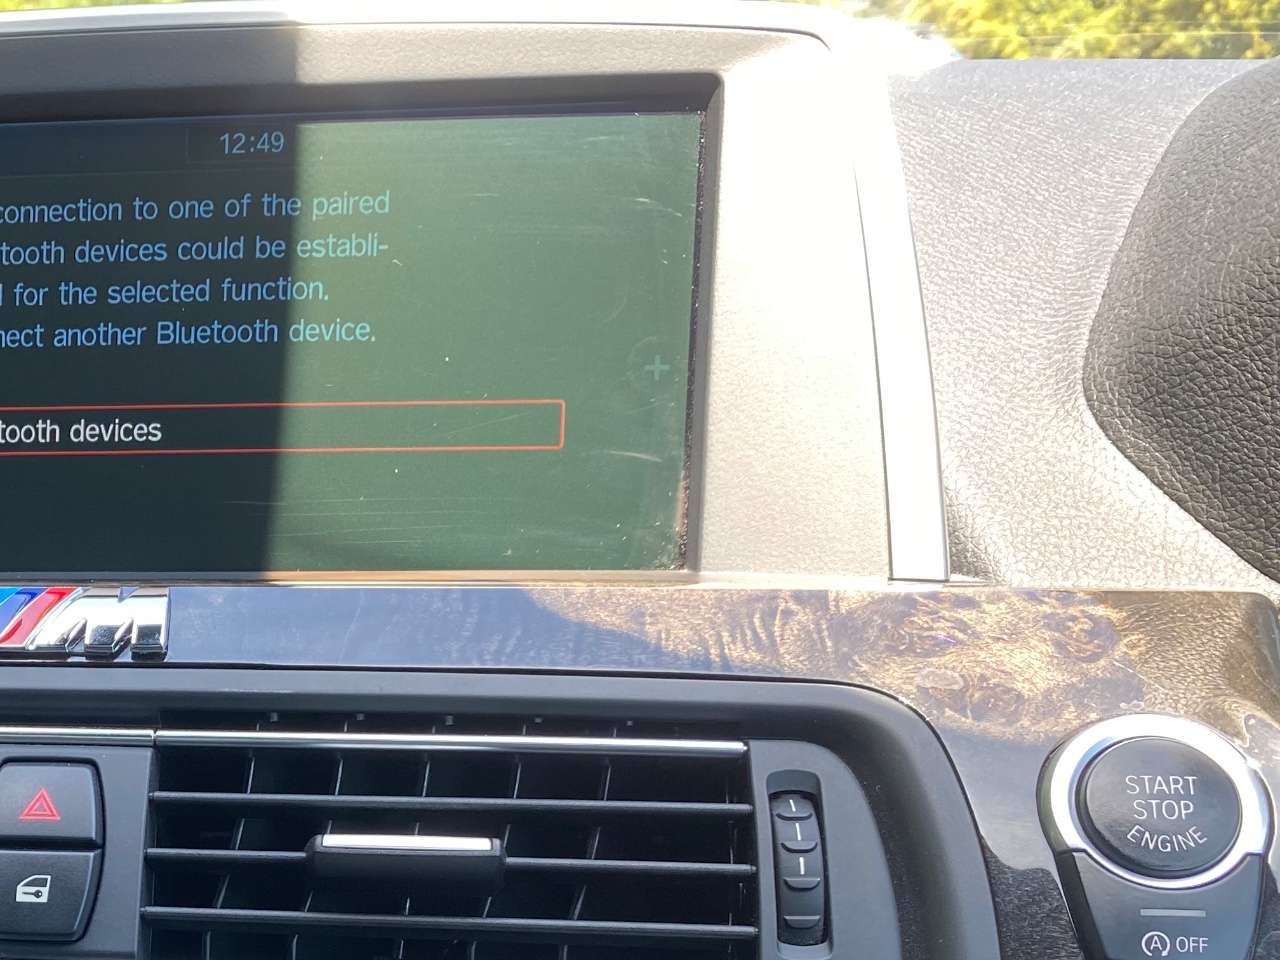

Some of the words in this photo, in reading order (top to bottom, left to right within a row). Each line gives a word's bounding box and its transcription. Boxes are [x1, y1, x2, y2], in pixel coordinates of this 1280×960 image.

[219, 131, 285, 154] 12:49
[133, 196, 158, 221] to
[168, 198, 214, 219] one
[224, 194, 252, 217] of
[261, 192, 301, 216] the
[311, 190, 391, 222] paired
[74, 238, 167, 264] devices
[177, 235, 245, 261] could
[255, 235, 286, 259] be
[296, 232, 389, 258] establi-
[13, 282, 49, 307] for
[59, 280, 97, 305] the
[107, 278, 210, 305] selected
[221, 276, 330, 303] function.
[53, 321, 147, 347] another
[157, 319, 278, 345] Bluetooth
[288, 317, 377, 343] device.
[69, 417, 162, 443] devices
[1124, 775, 1199, 796] START
[1132, 799, 1195, 820] STOP
[1126, 824, 1209, 852] ENGINE
[1176, 936, 1209, 953] OFF
